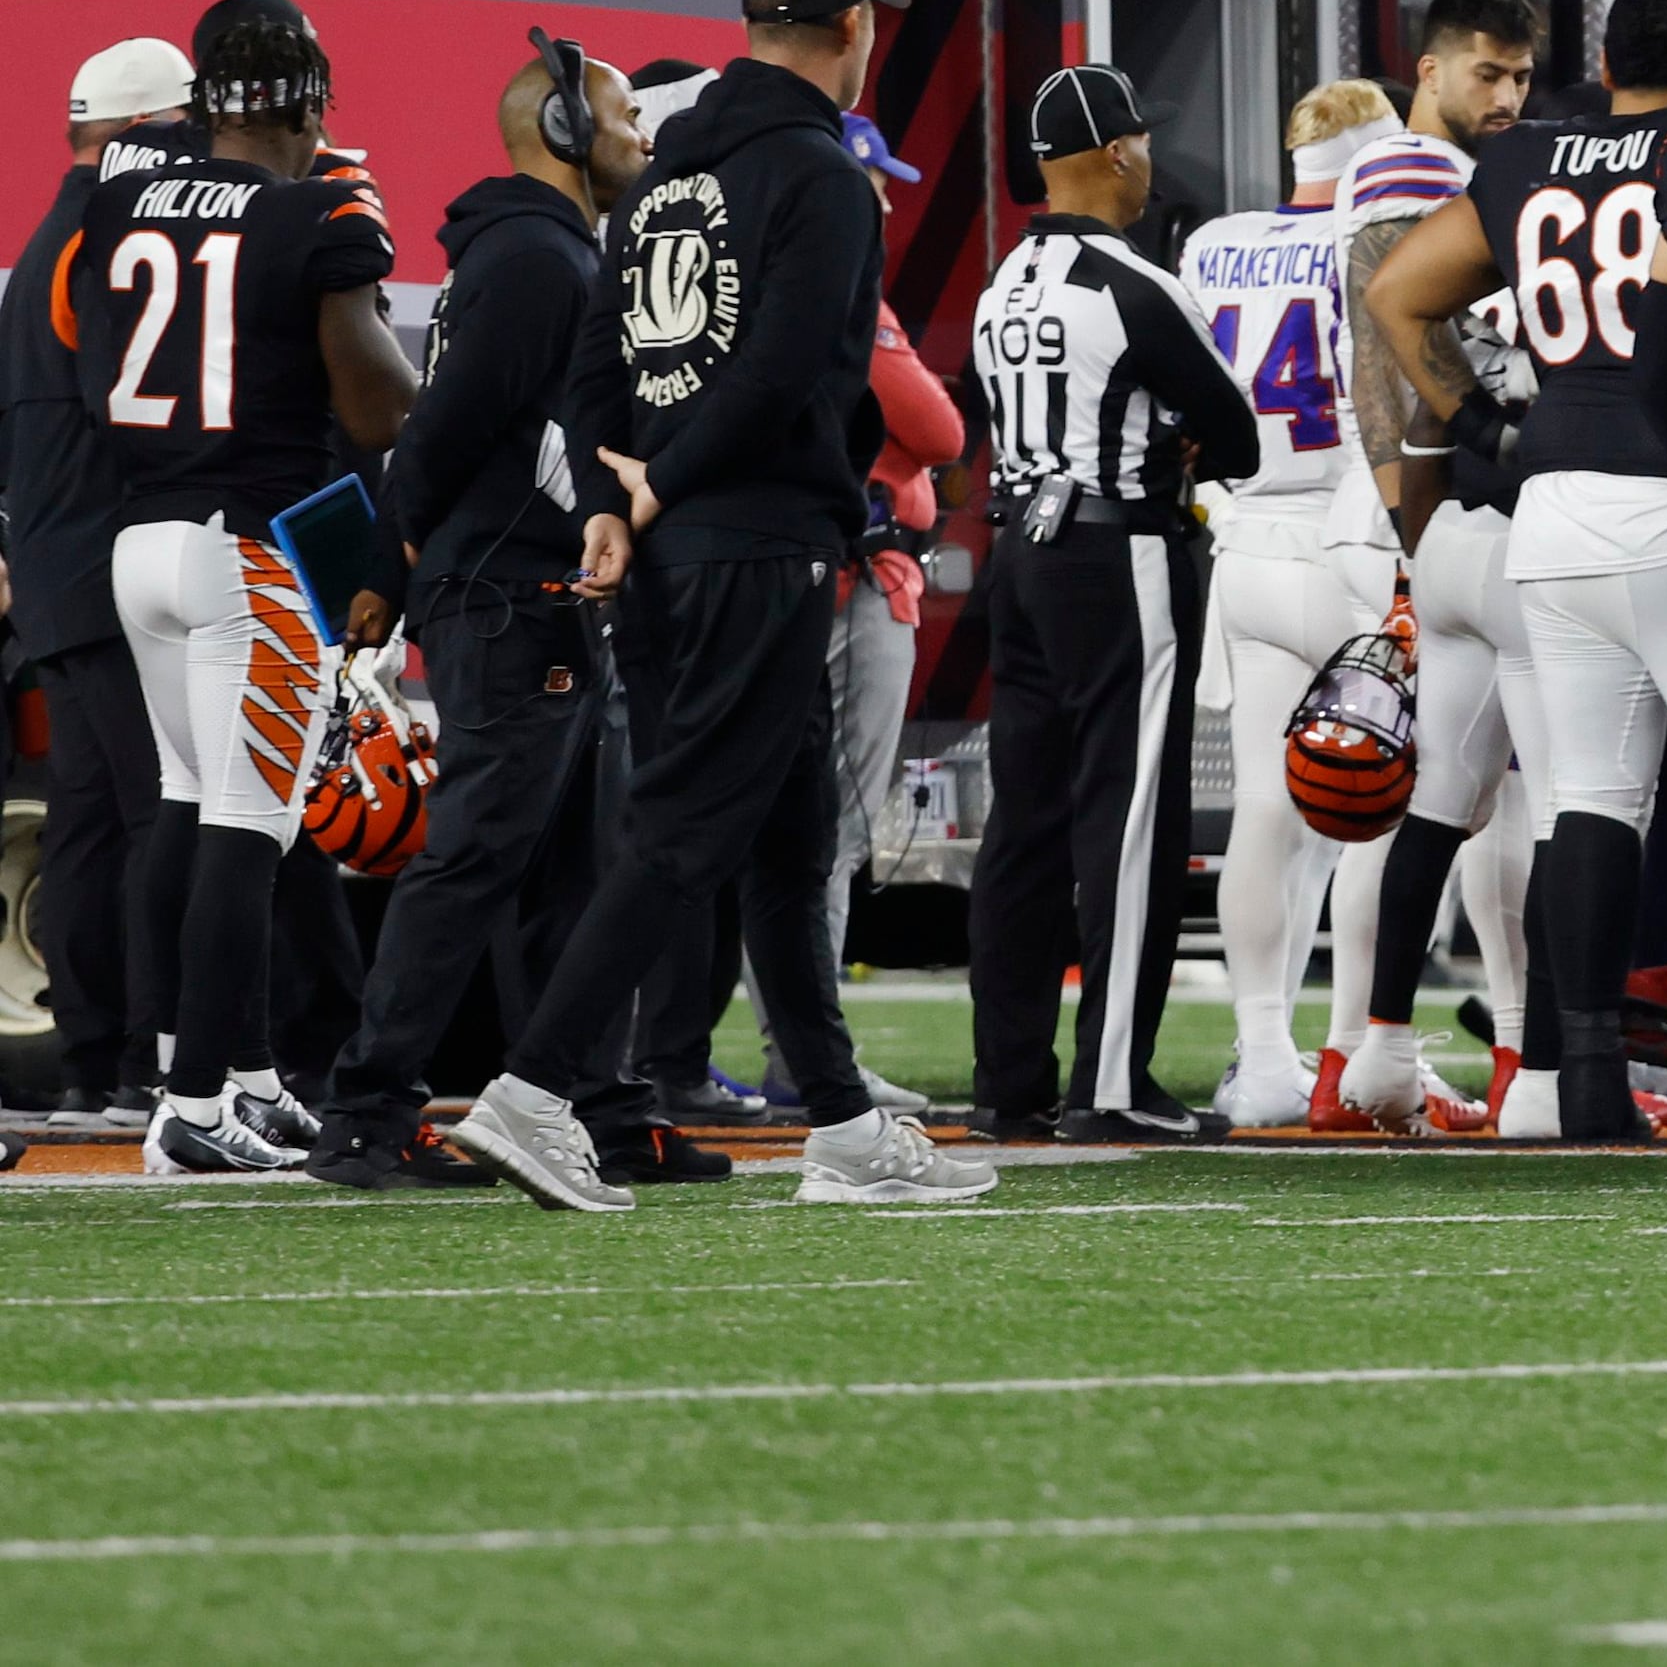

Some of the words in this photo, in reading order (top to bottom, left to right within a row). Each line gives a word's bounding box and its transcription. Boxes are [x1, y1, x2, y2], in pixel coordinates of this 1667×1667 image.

[1549, 129, 1658, 177] TUPOU
[132, 178, 261, 220] HILTON
[706, 258, 741, 354] EQUITY
[1515, 180, 1662, 366] 68
[108, 229, 242, 431] 21
[979, 315, 1066, 369] 109
